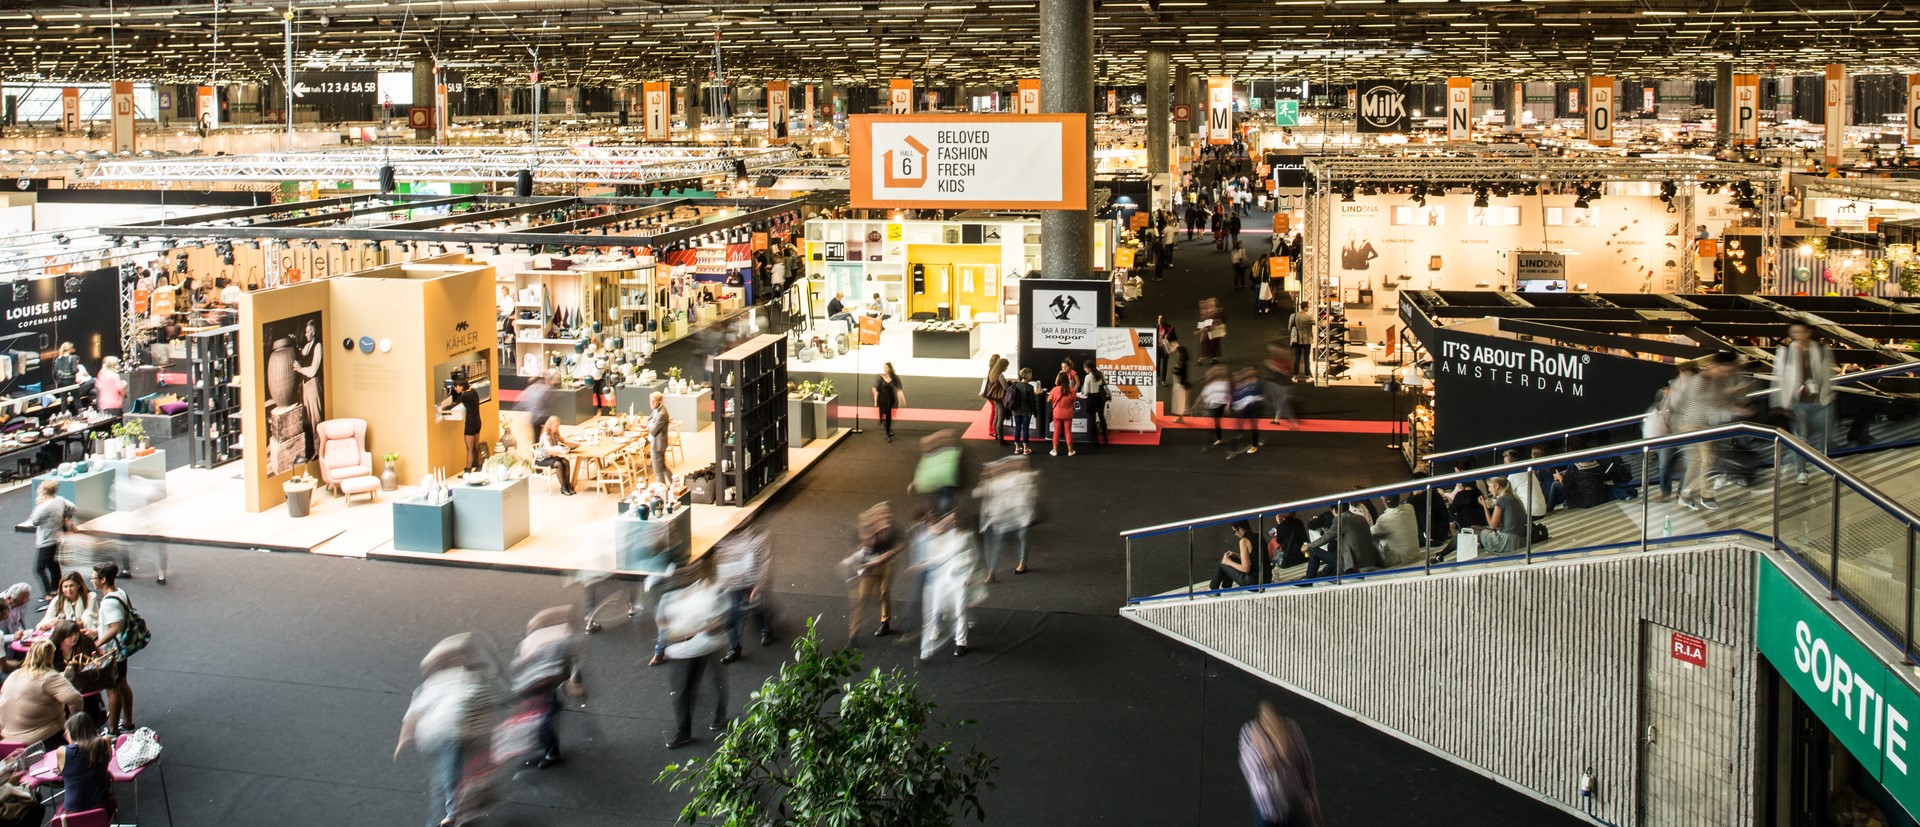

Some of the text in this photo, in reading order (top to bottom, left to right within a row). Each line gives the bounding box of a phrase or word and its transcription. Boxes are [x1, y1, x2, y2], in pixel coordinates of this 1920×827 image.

[320, 82, 326, 92] 1
[327, 82, 334, 92] 2
[335, 82, 342, 92] 3
[343, 82, 350, 92] 4
[351, 82, 363, 92] 5A
[364, 82, 376, 92] 5B
[1570, 98, 1576, 108] S
[1646, 98, 1651, 106] T
[1212, 108, 1228, 130] M
[1453, 108, 1466, 130] N
[1740, 106, 1752, 129] P
[938, 130, 990, 144] BELOVED
[938, 147, 988, 160] FASHION
[902, 158, 912, 176] 6
[938, 163, 975, 176] FRESH
[938, 180, 964, 192] KIDS
[826, 244, 844, 256] Fill
[1520, 260, 1563, 268] LINDDNA
[6, 298, 78, 320] LOUISE ROE
[18, 314, 68, 329] COPENHAGEN
[446, 331, 478, 351] KÄHLER
[1473, 346, 1526, 370] ABOUT
[1794, 620, 1908, 776] SORTIE
